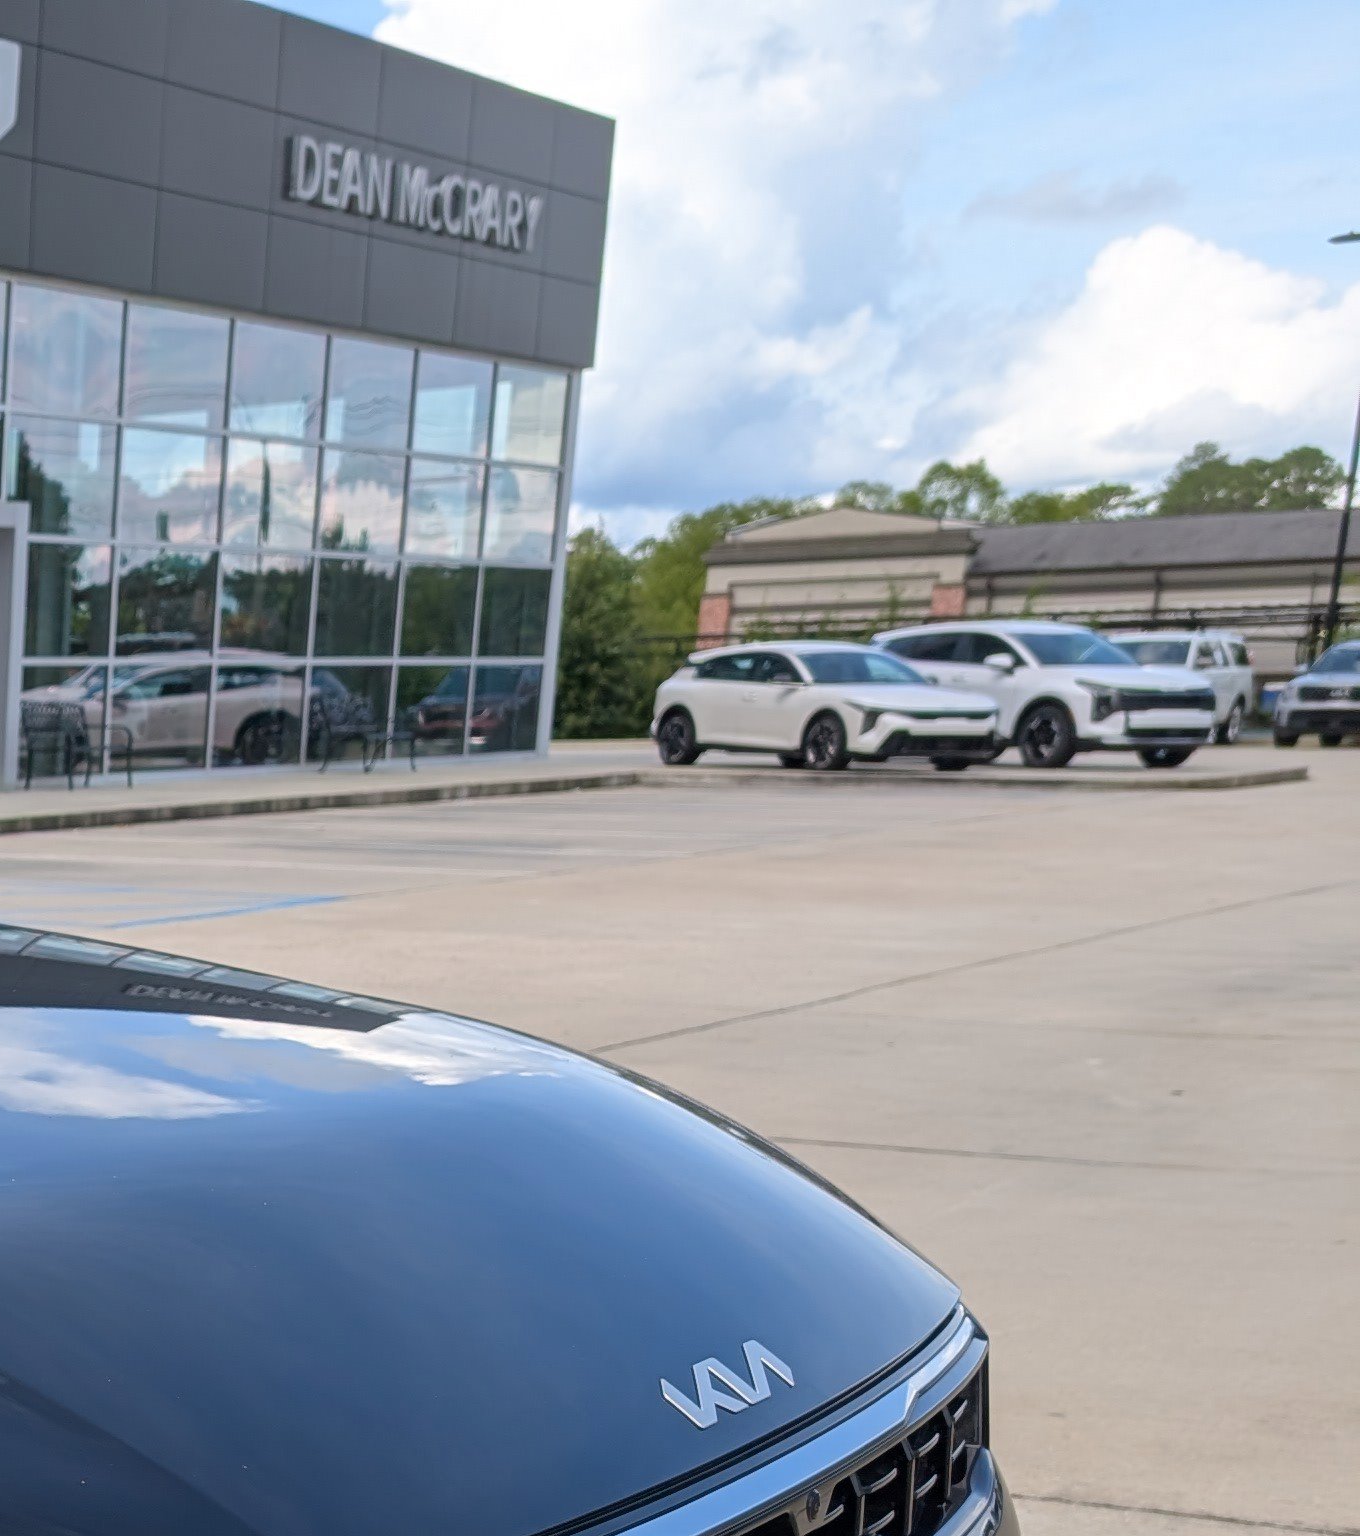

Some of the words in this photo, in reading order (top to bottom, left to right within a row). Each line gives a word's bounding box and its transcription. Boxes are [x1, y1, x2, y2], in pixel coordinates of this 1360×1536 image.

[288, 134, 394, 220] DEAN
[394, 160, 543, 252] McCRARY
[660, 1339, 795, 1430] KIA
